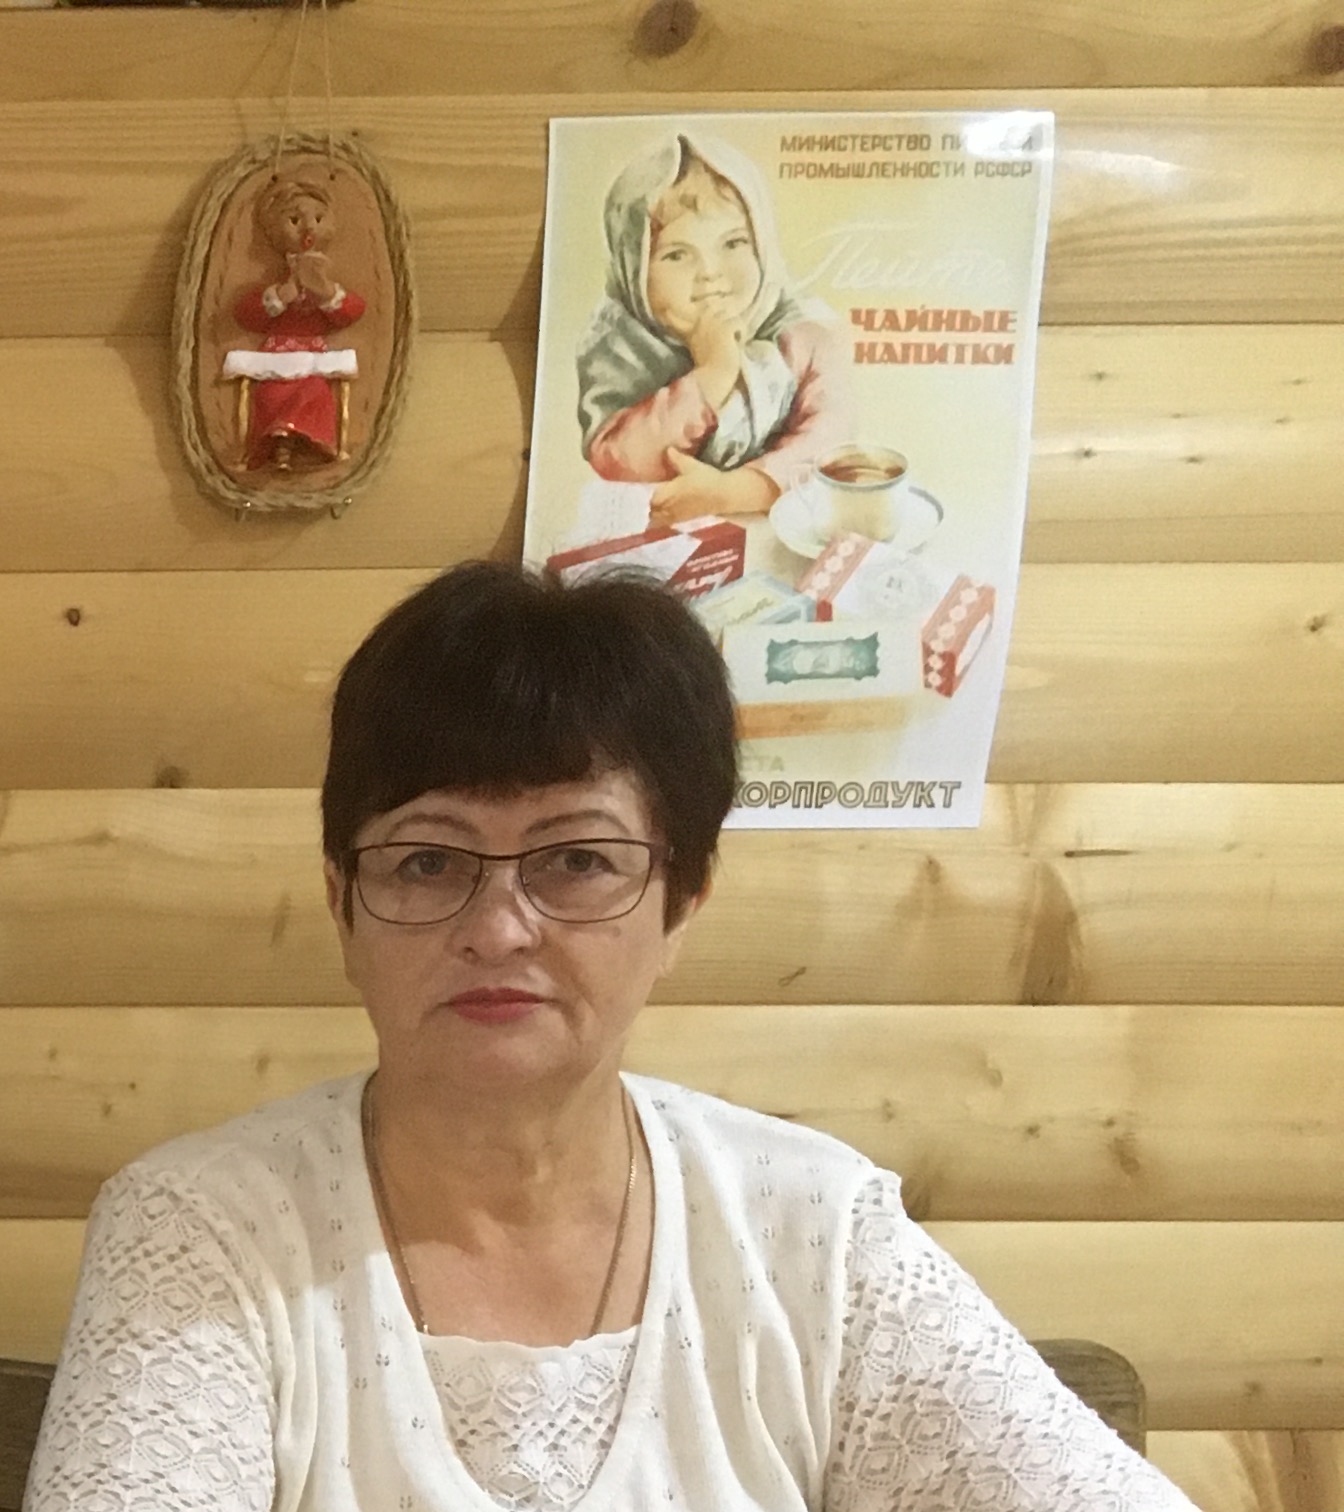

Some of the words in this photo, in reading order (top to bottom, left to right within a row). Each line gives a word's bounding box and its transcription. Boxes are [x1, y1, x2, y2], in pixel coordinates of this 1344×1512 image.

[780, 134, 931, 152] МИНИСТЕРСТВО
[778, 160, 965, 179] ПРОМЫШЛЕННОСТИ
[974, 161, 1033, 179] РСФСР
[850, 305, 1018, 333] ЧАЙНЫЕ
[853, 342, 1015, 365] НАПИТКИ
